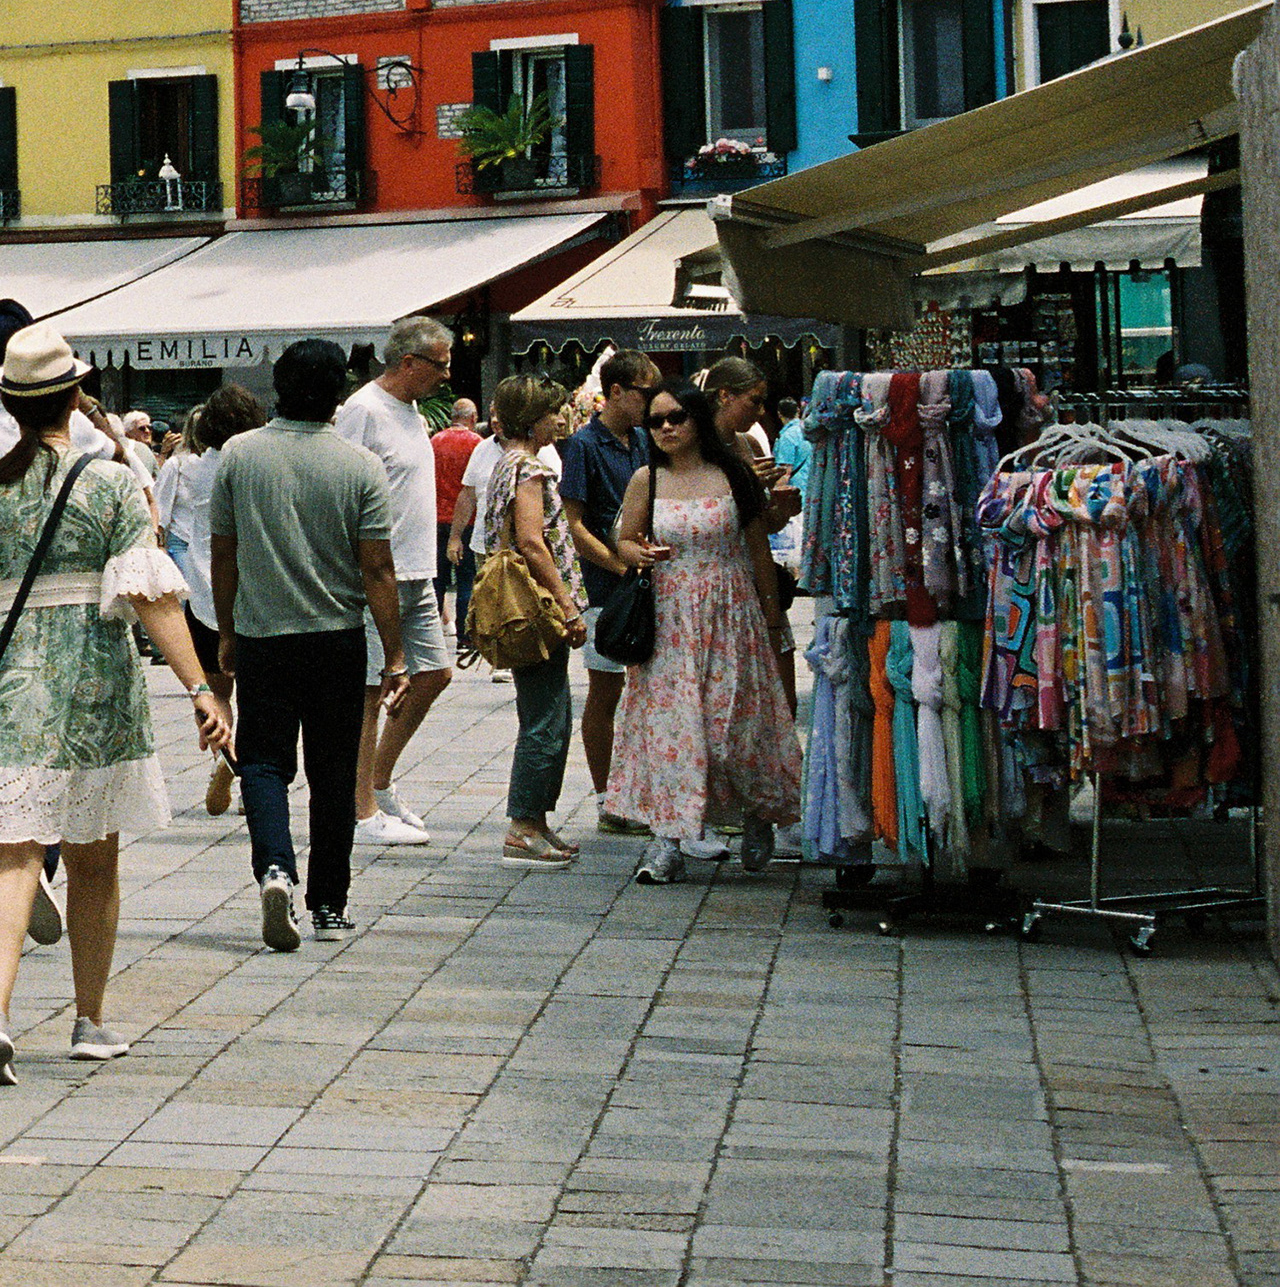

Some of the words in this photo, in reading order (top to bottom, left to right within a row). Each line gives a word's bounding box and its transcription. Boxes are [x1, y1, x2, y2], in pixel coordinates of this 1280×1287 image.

[137, 337, 253, 361] EMILIA
[673, 341, 706, 350] GELATO
[179, 360, 214, 368] BURANO
